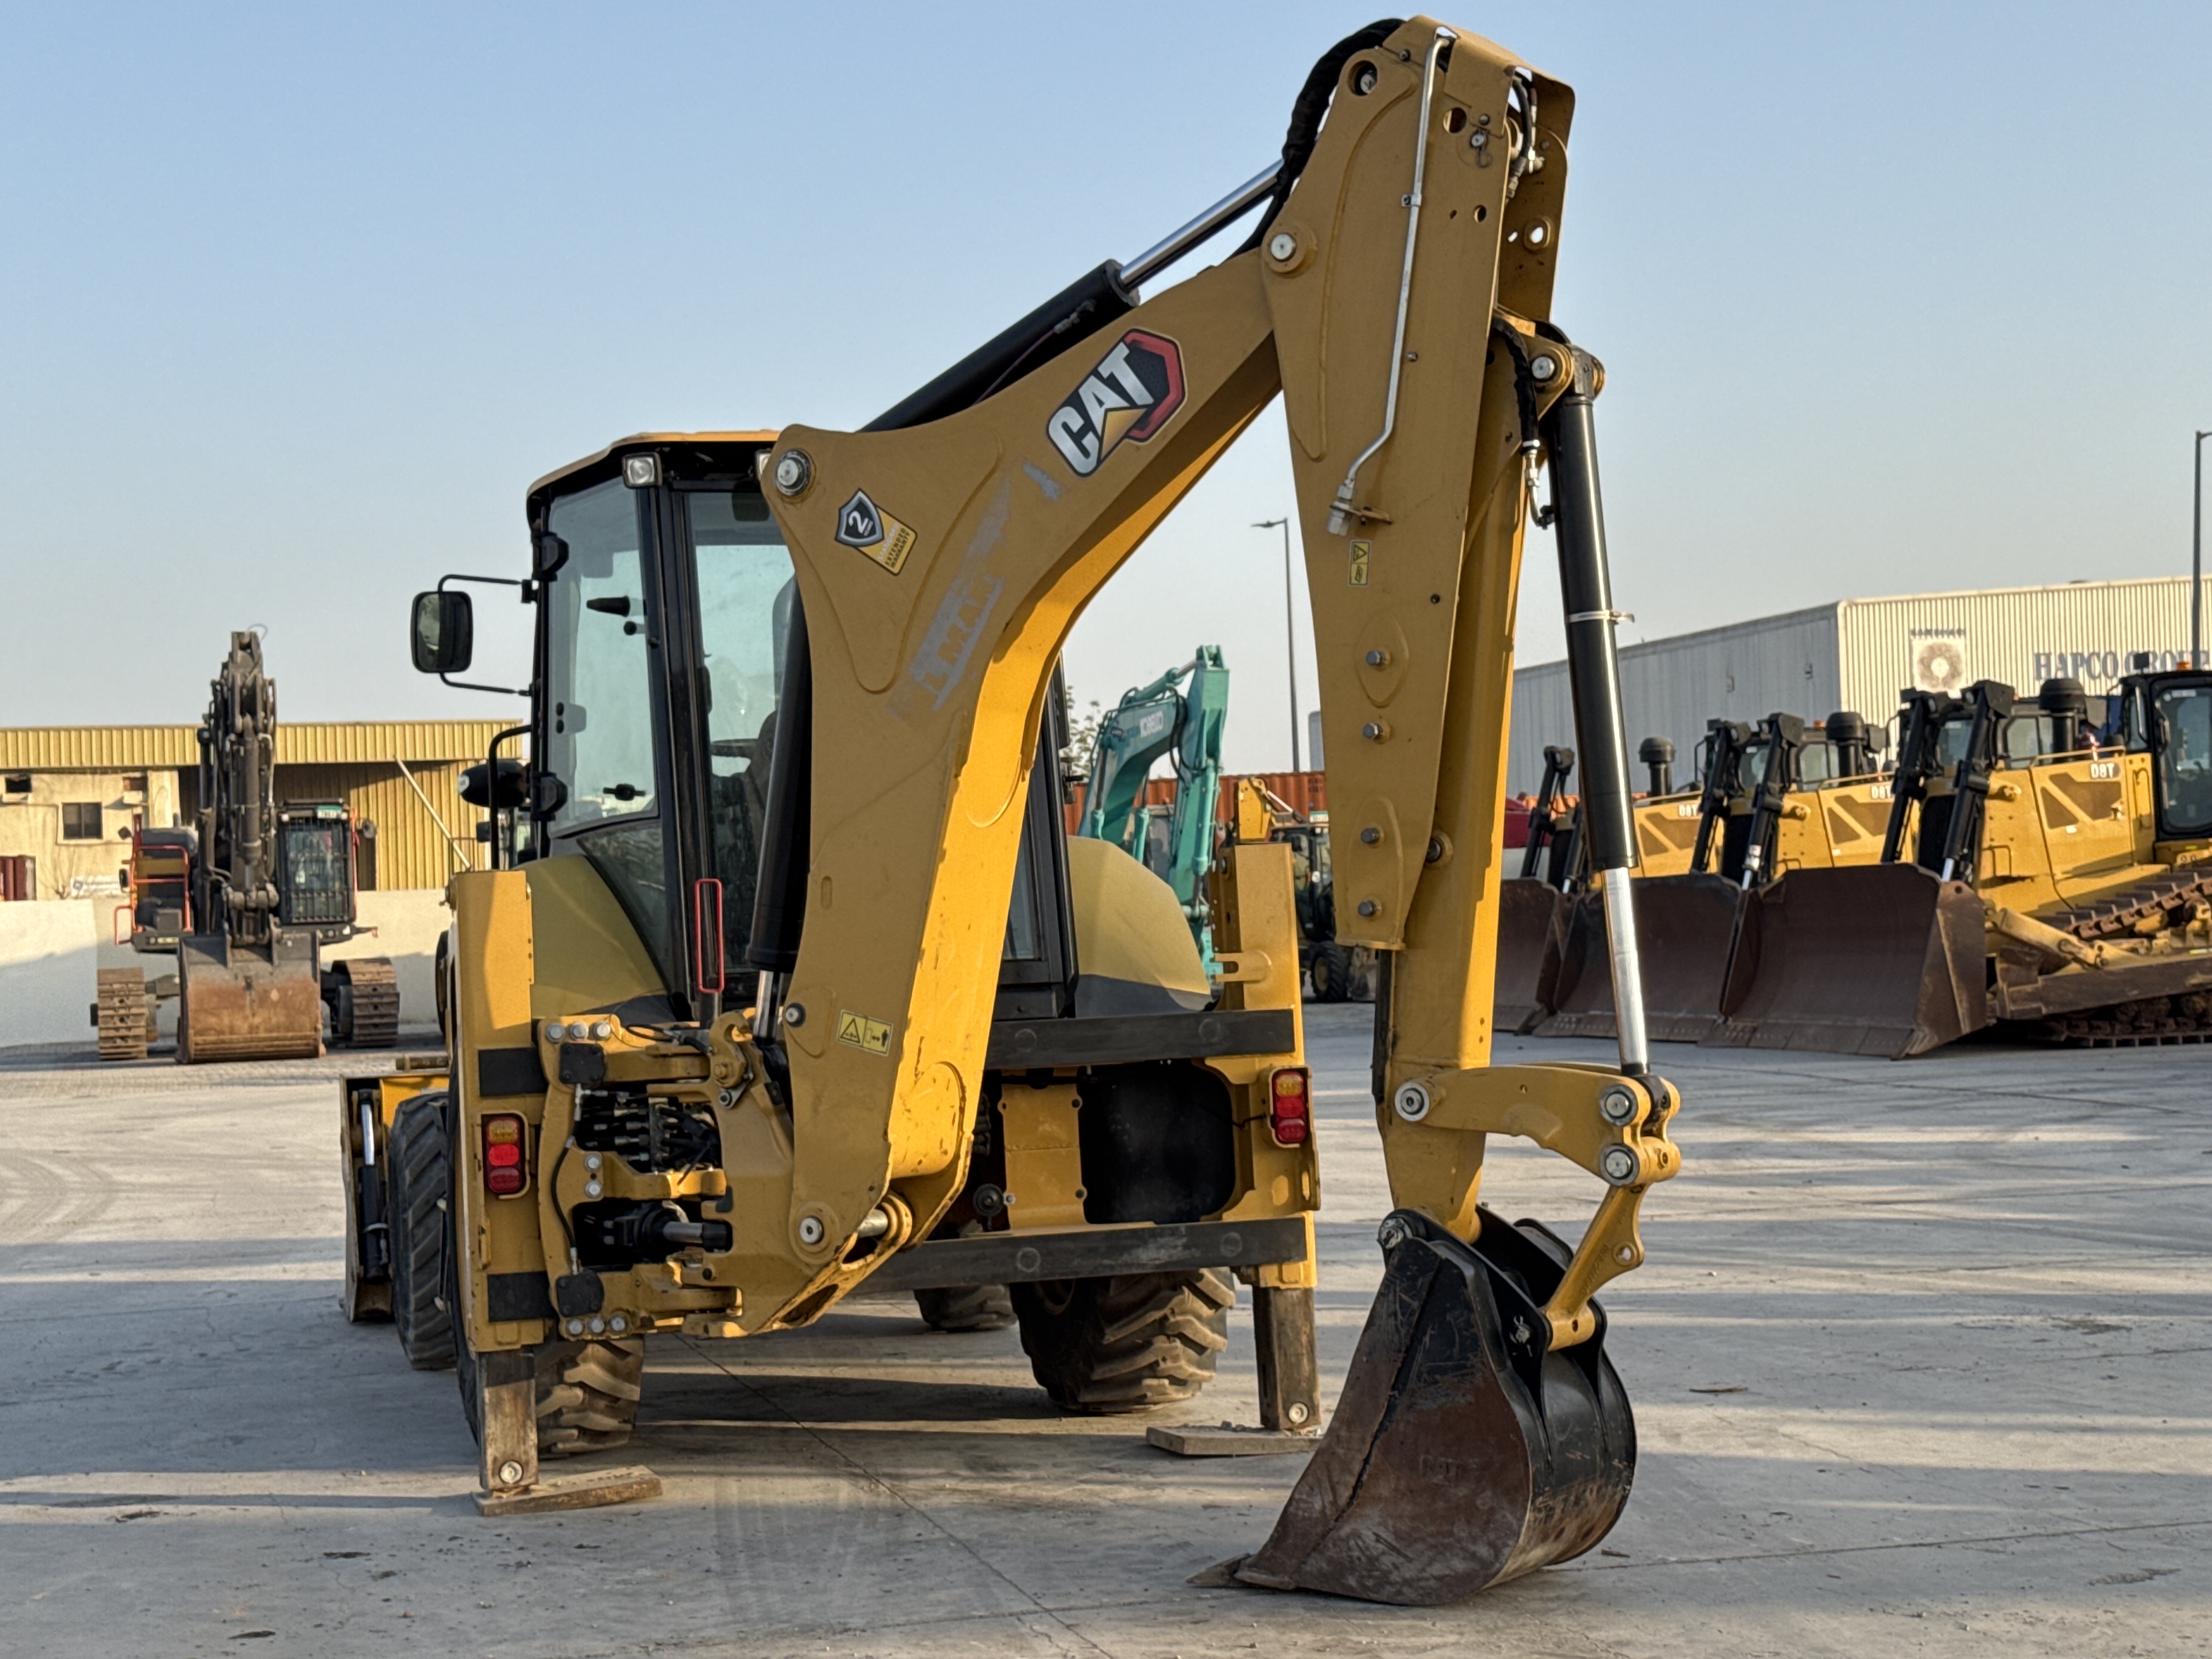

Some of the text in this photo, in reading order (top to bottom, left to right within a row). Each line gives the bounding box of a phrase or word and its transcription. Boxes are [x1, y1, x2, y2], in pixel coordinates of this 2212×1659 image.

[1048, 342, 1154, 473] CAT
[848, 511, 869, 534] 2
[2034, 650, 2119, 680] HAPCO
[2090, 763, 2115, 778] D8T
